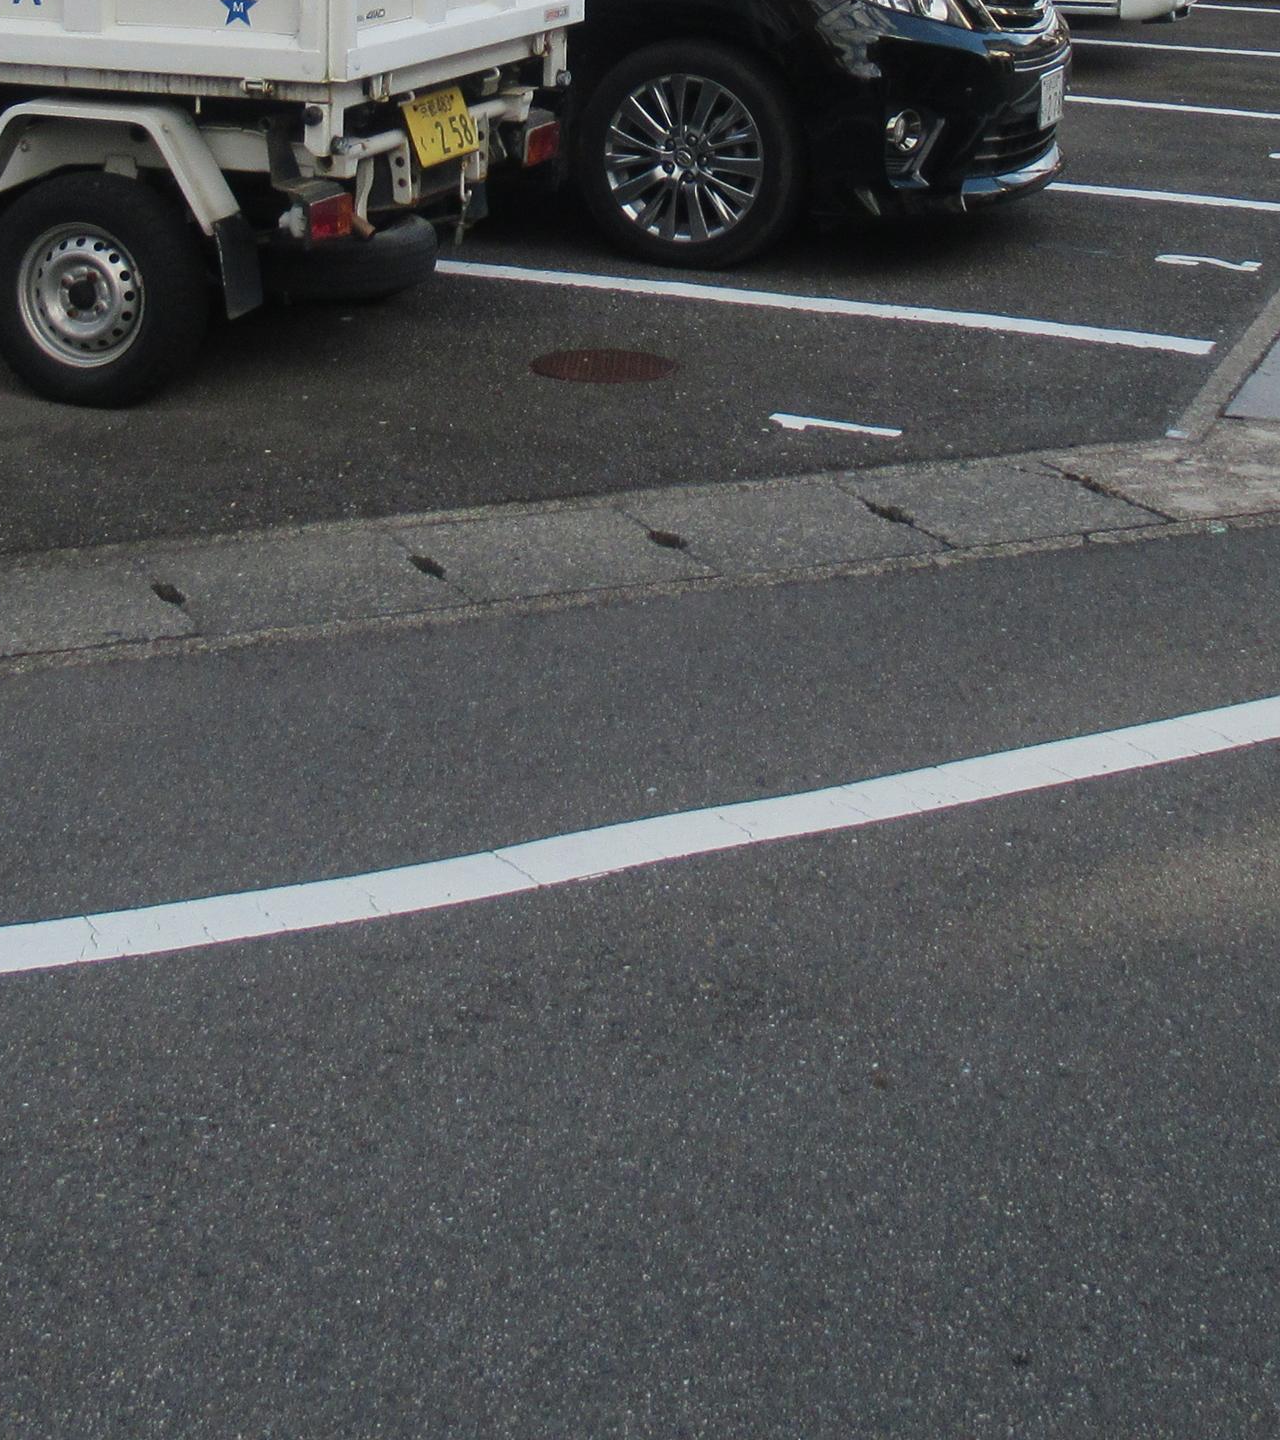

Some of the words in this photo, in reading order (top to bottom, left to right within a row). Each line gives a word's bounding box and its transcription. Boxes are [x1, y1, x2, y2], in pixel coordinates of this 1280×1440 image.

[233, 1, 245, 12] M
[1155, 254, 1263, 271] 2
[769, 412, 903, 438] 1
